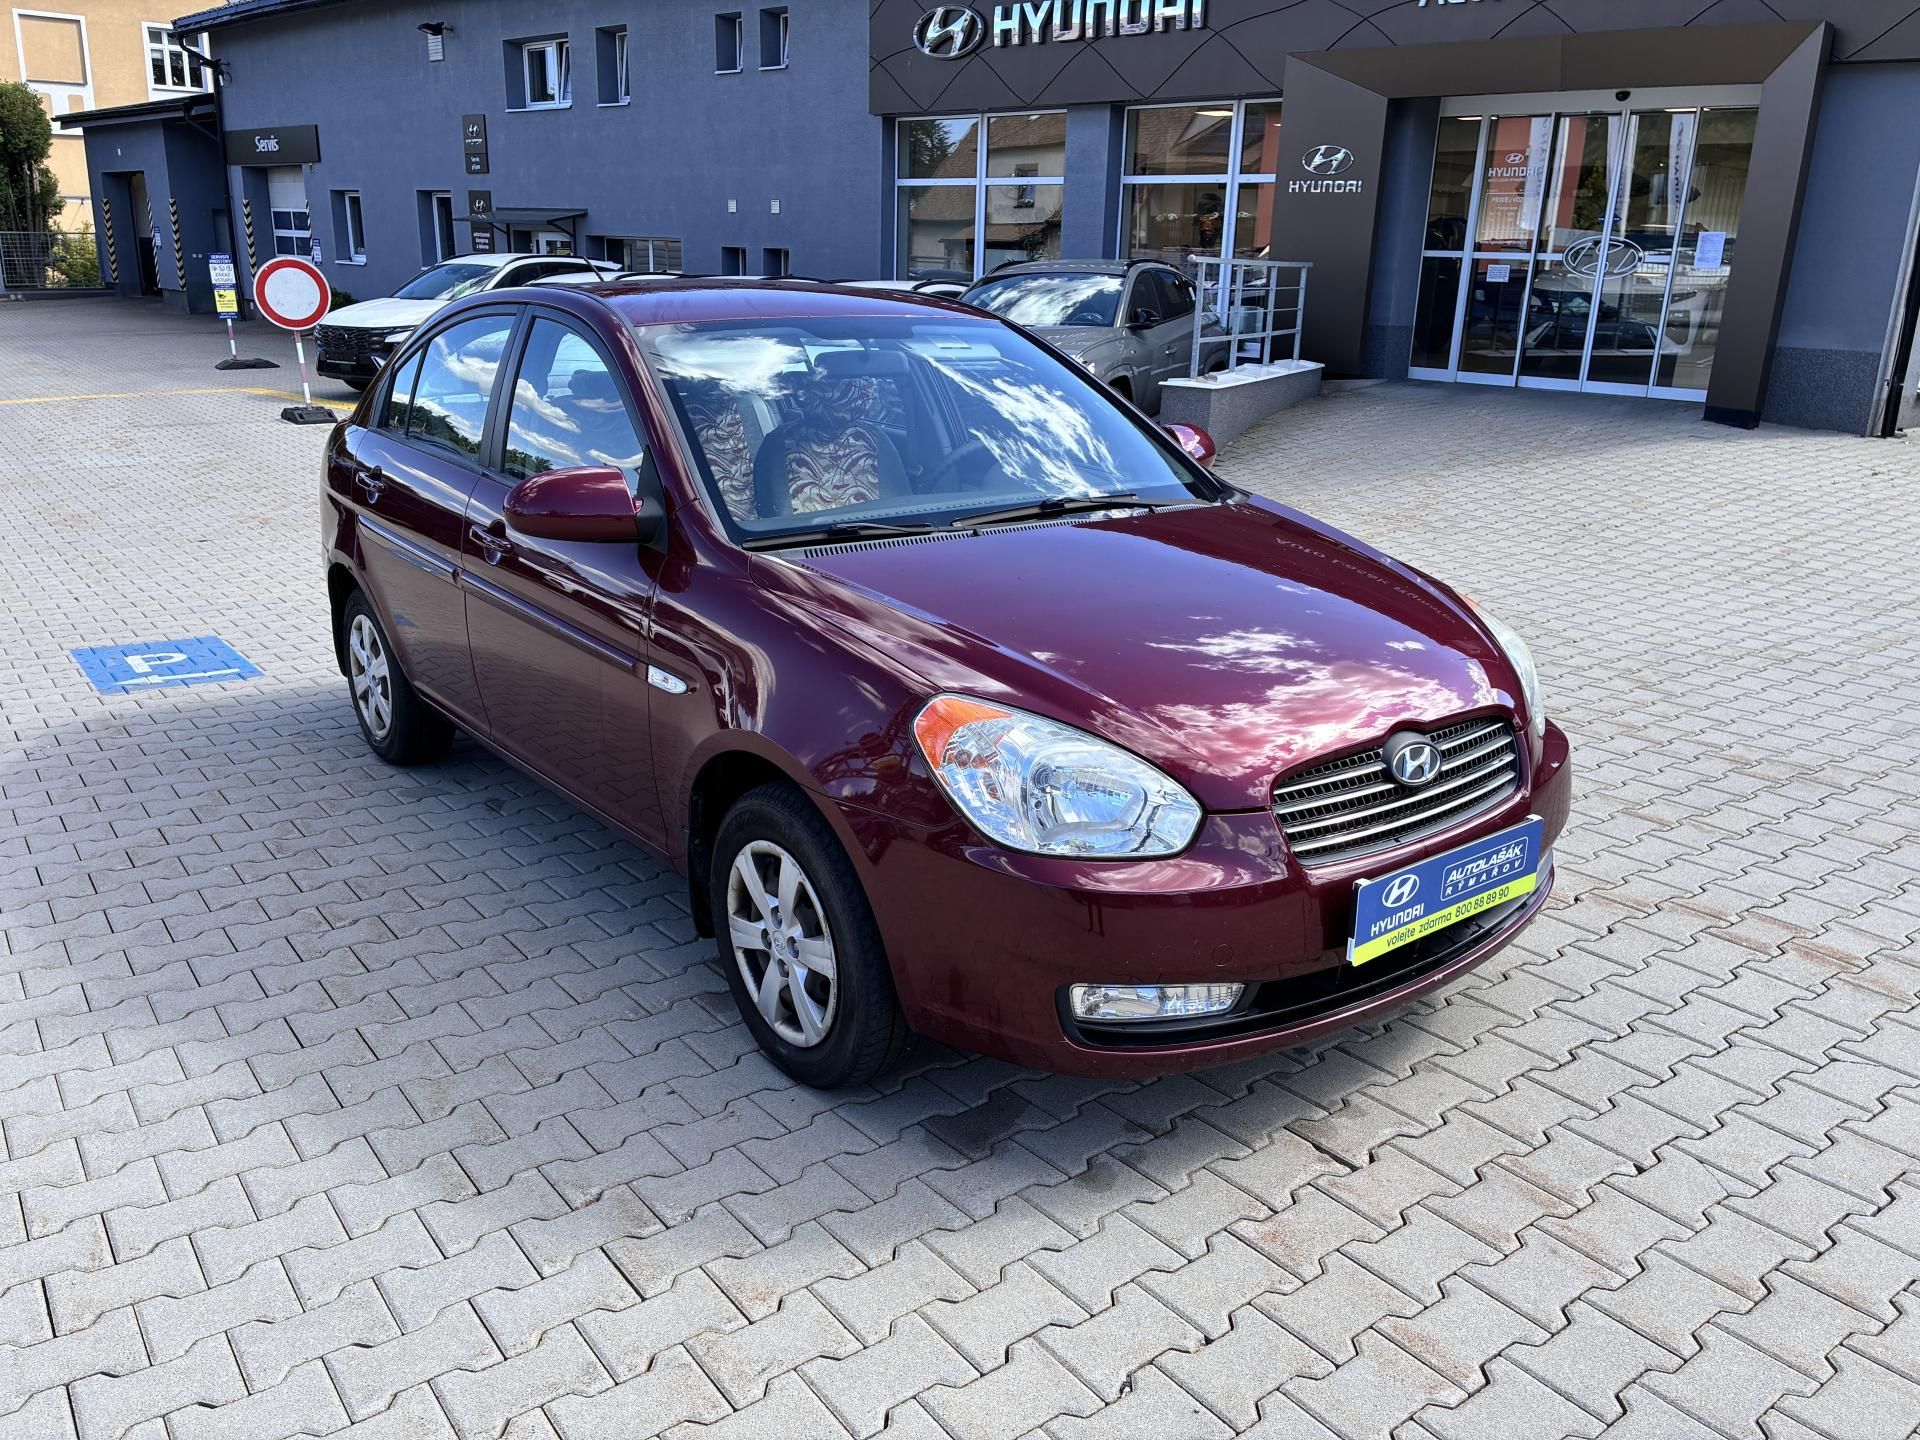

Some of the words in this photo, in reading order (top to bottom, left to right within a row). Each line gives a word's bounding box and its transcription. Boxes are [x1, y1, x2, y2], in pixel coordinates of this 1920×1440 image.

[993, 0, 1206, 47] HYUNDAI
[254, 134, 280, 153] Servis
[1288, 180, 1363, 193] HYUNDAI
[123, 652, 188, 674] P
[1446, 842, 1524, 884] AUTOLAŠÁK
[1370, 902, 1425, 937] HYUNDAI
[1386, 927, 1416, 948] volejte
[1418, 912, 1452, 934] zdarma
[1454, 901, 1473, 918] 800
[1473, 897, 1485, 910] 88
[1485, 891, 1497, 905] 89
[1498, 885, 1510, 899] 90
